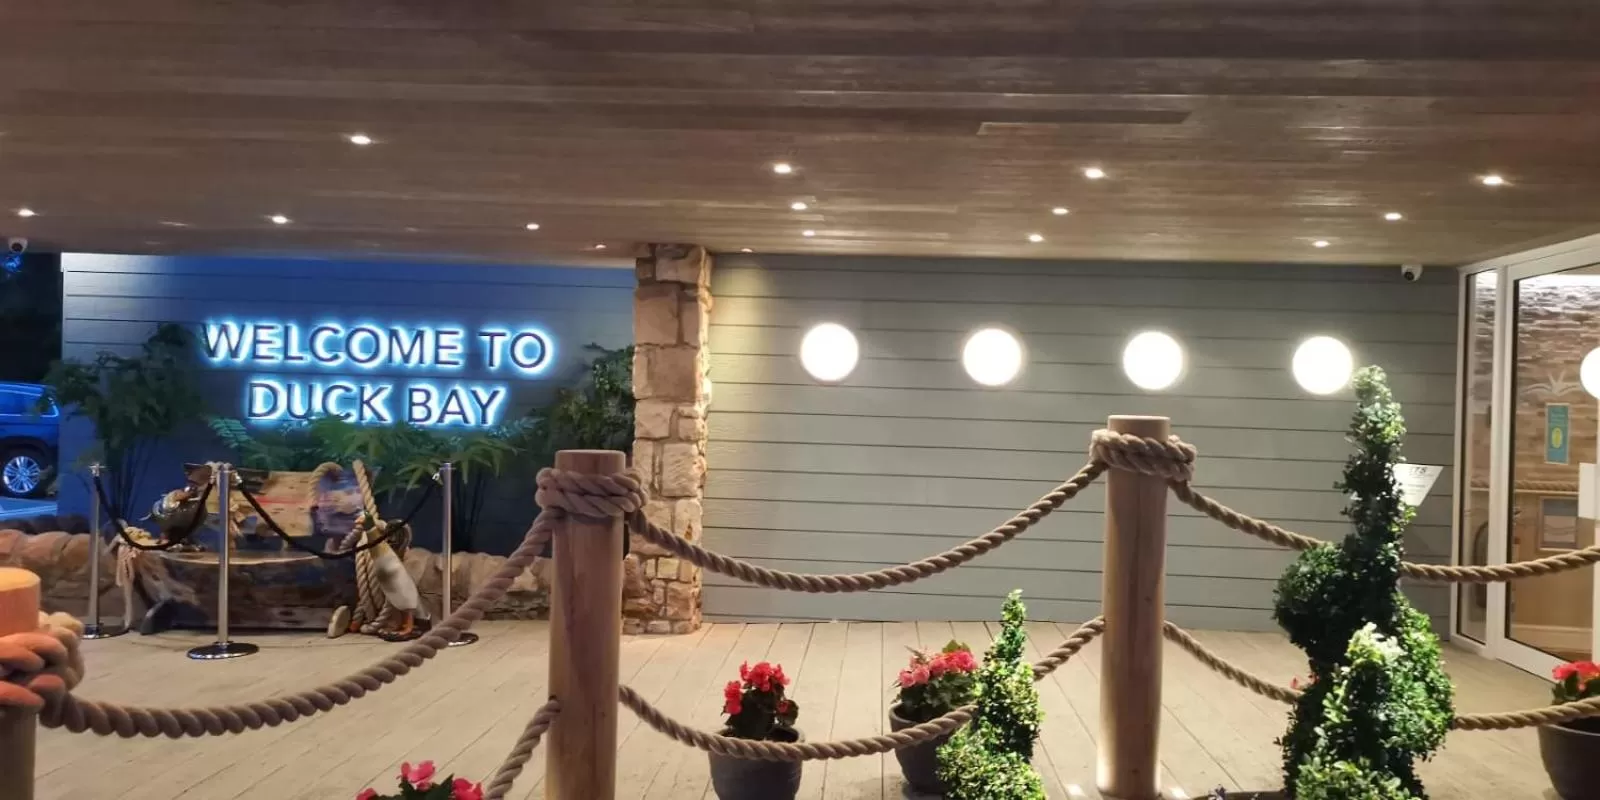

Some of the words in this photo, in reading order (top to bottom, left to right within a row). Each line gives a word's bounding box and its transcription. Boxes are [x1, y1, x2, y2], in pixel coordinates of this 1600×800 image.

[201, 321, 461, 366] WELCOME
[477, 331, 547, 369] TO
[247, 382, 389, 422] DUCK
[407, 387, 502, 425] BAY
